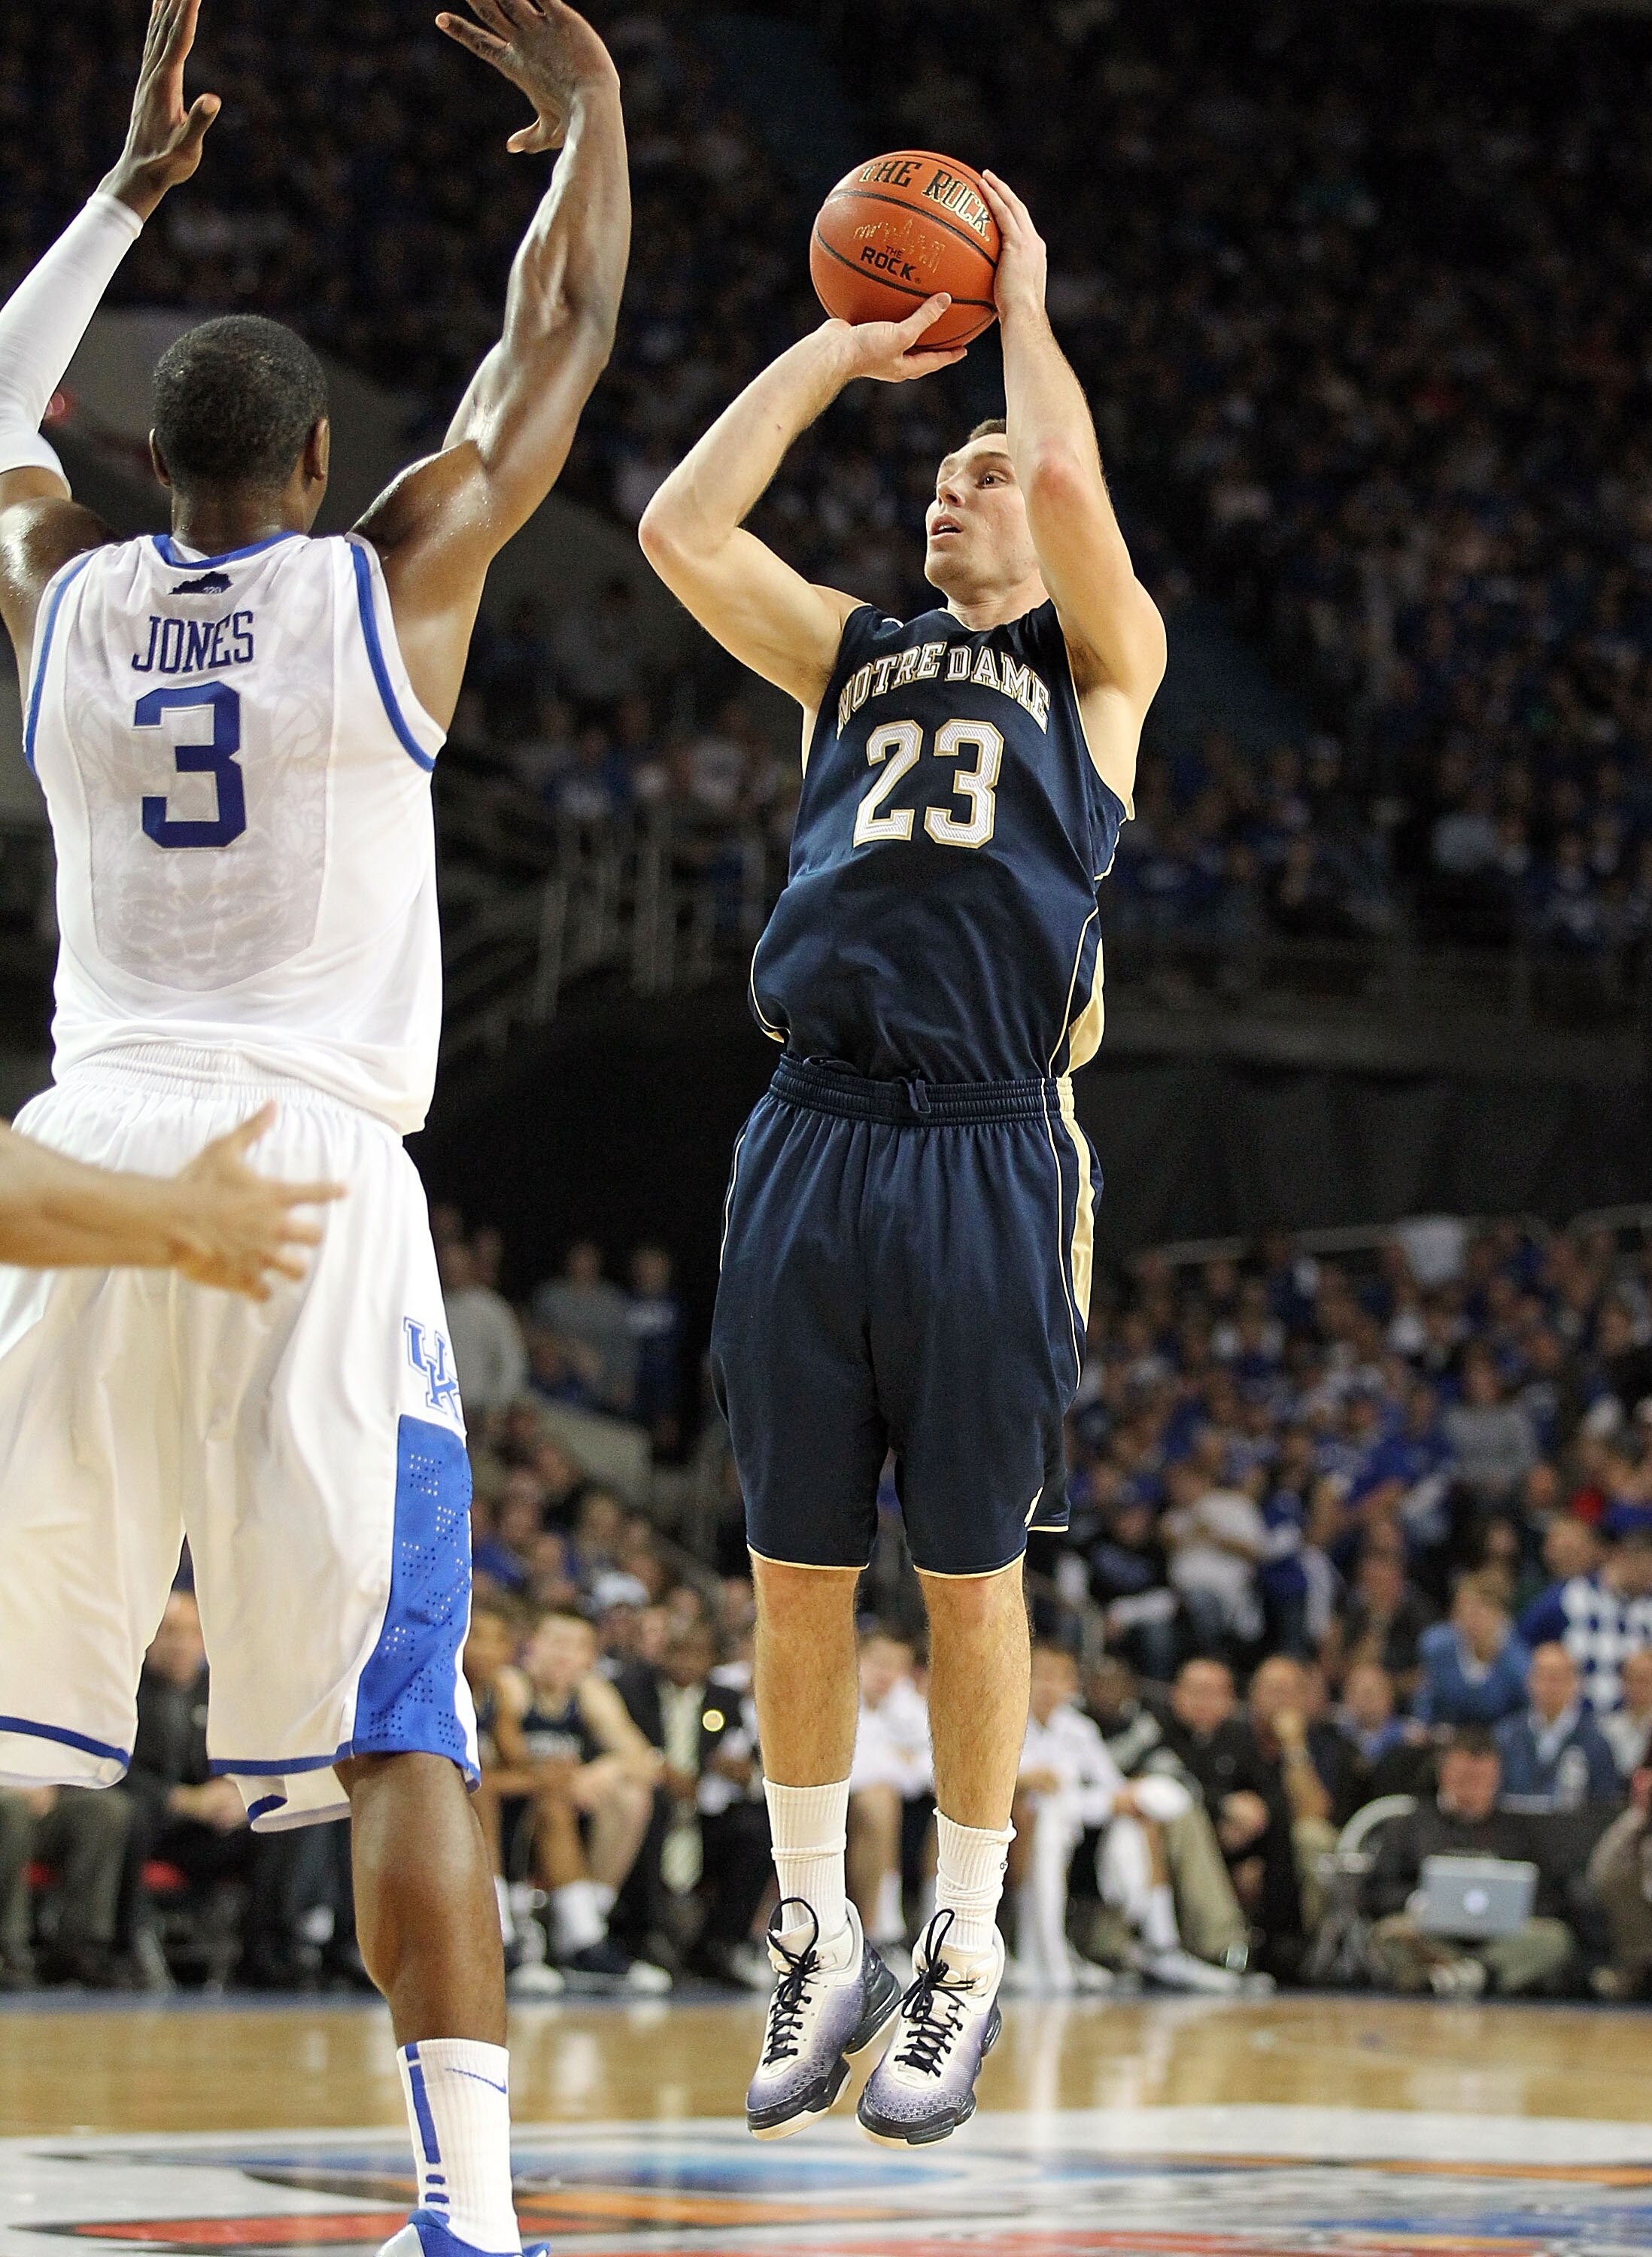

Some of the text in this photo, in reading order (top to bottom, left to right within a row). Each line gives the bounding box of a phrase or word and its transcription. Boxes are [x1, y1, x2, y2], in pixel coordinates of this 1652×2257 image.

[859, 159, 993, 238] THE ROCK
[860, 245, 916, 282] ROCK
[885, 245, 903, 259] THE
[132, 610, 254, 674] JONES
[837, 641, 1051, 741] NOTRE DAME
[132, 680, 247, 849] 3
[853, 718, 1005, 849] 23
